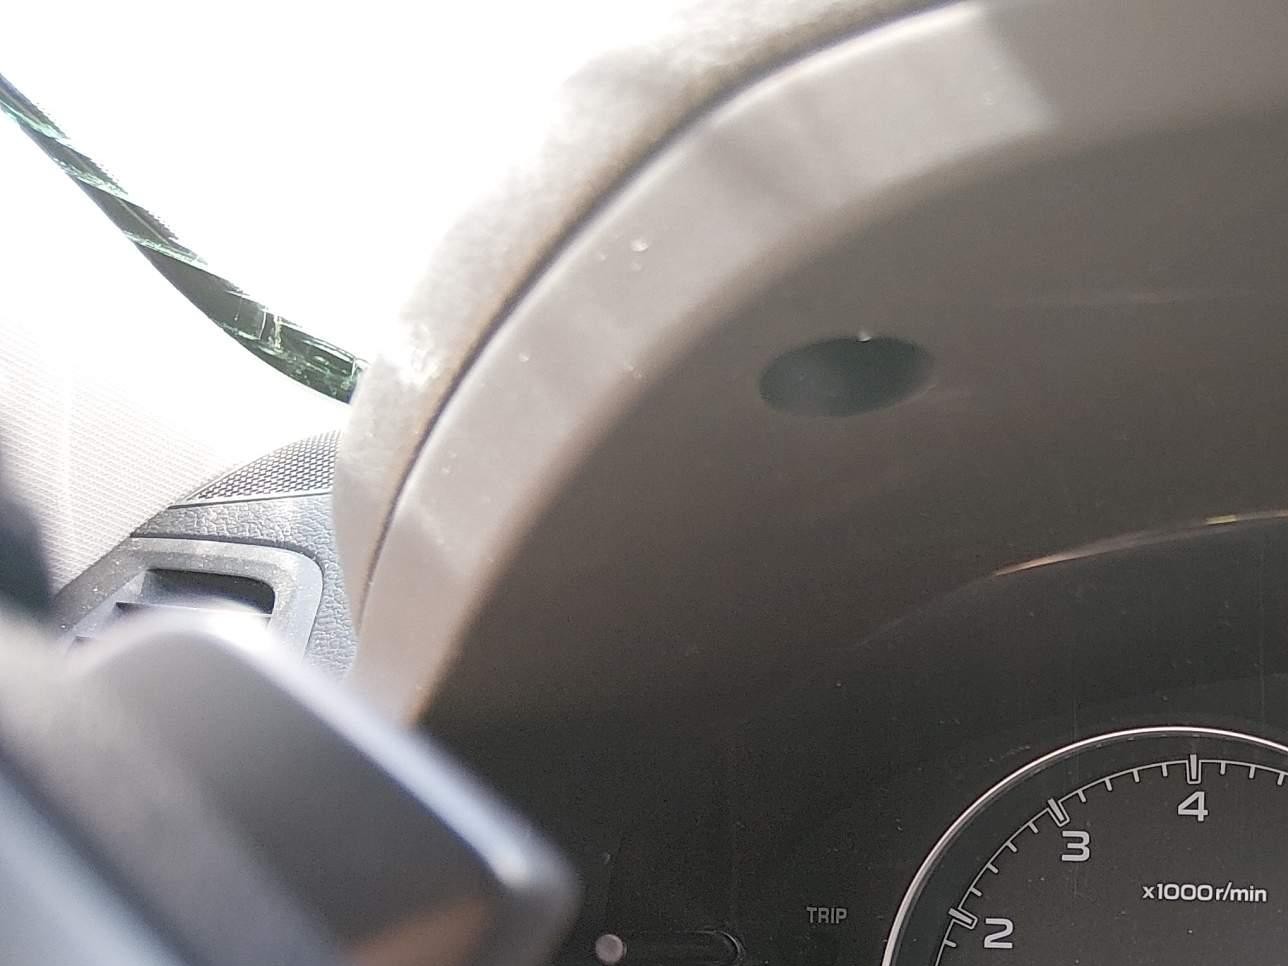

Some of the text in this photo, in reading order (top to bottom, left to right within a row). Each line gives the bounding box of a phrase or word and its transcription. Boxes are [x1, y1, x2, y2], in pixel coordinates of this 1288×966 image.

[1177, 791, 1208, 821] 4
[1061, 831, 1090, 861] 3
[806, 907, 847, 924] TRIP
[984, 918, 1013, 949] 2
